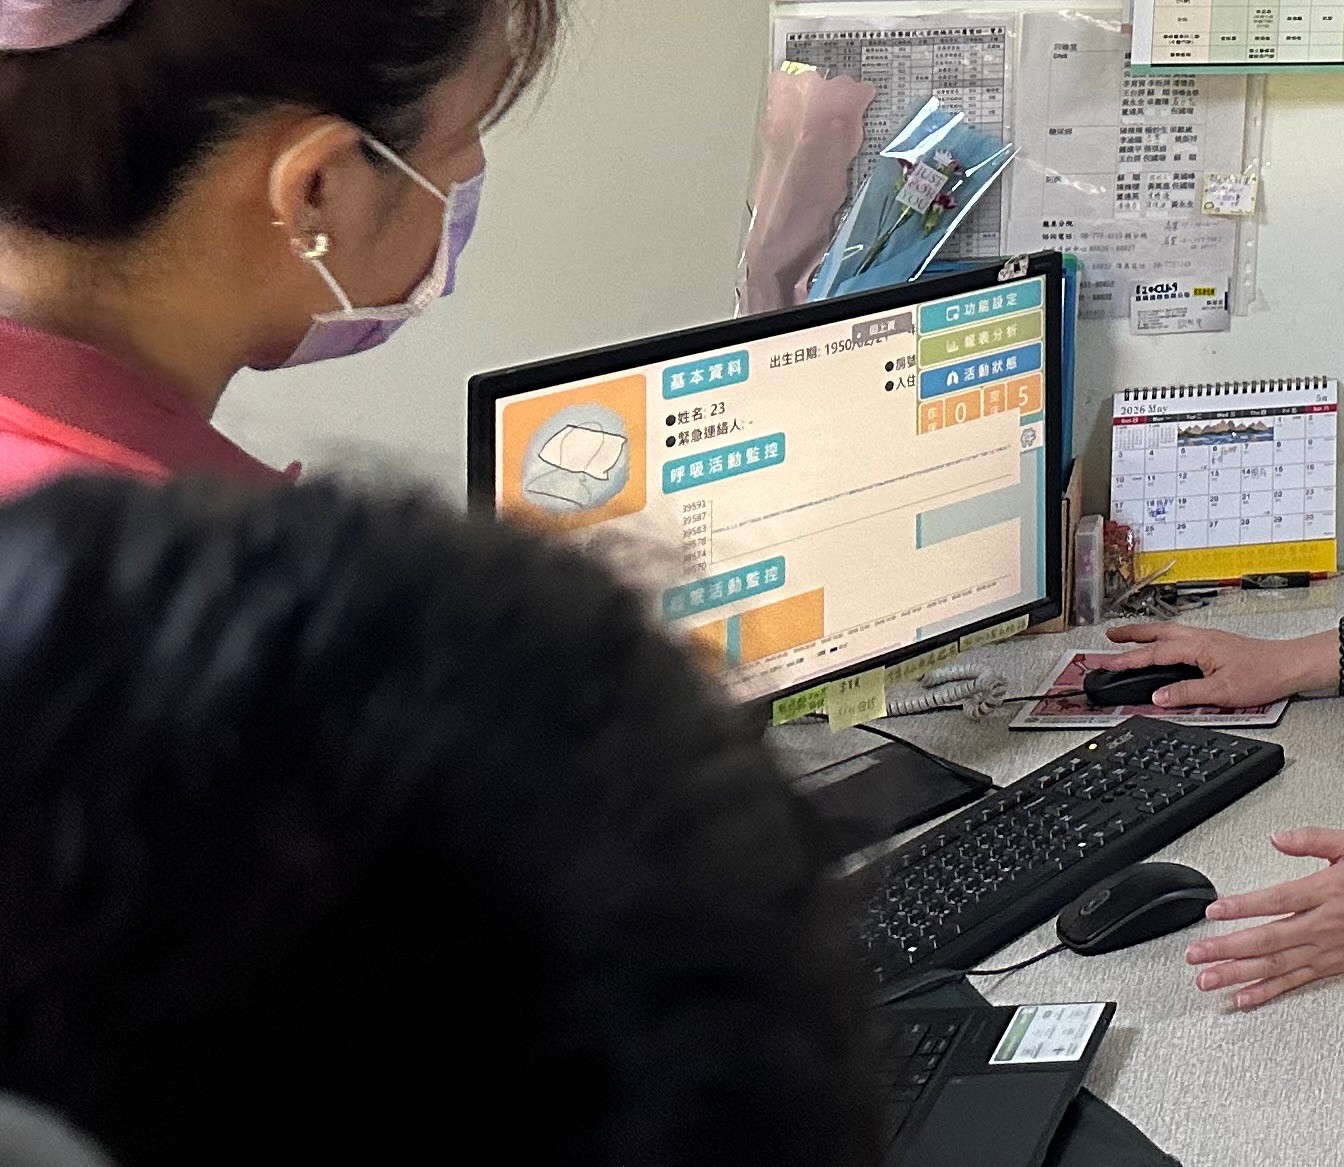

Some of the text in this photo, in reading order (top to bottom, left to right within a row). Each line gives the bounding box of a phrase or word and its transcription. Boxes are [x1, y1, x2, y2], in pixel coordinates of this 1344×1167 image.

[964, 293, 1017, 316] 功能設定
[964, 324, 1017, 348] 報表分析
[671, 359, 741, 391] 基本資料
[964, 356, 1017, 382] 活動狀態
[1018, 385, 1029, 407] 5
[710, 402, 726, 416] 23
[954, 403, 967, 424] 0
[1121, 405, 1168, 415] 2026 May
[670, 442, 778, 484] 呼吸活動監控
